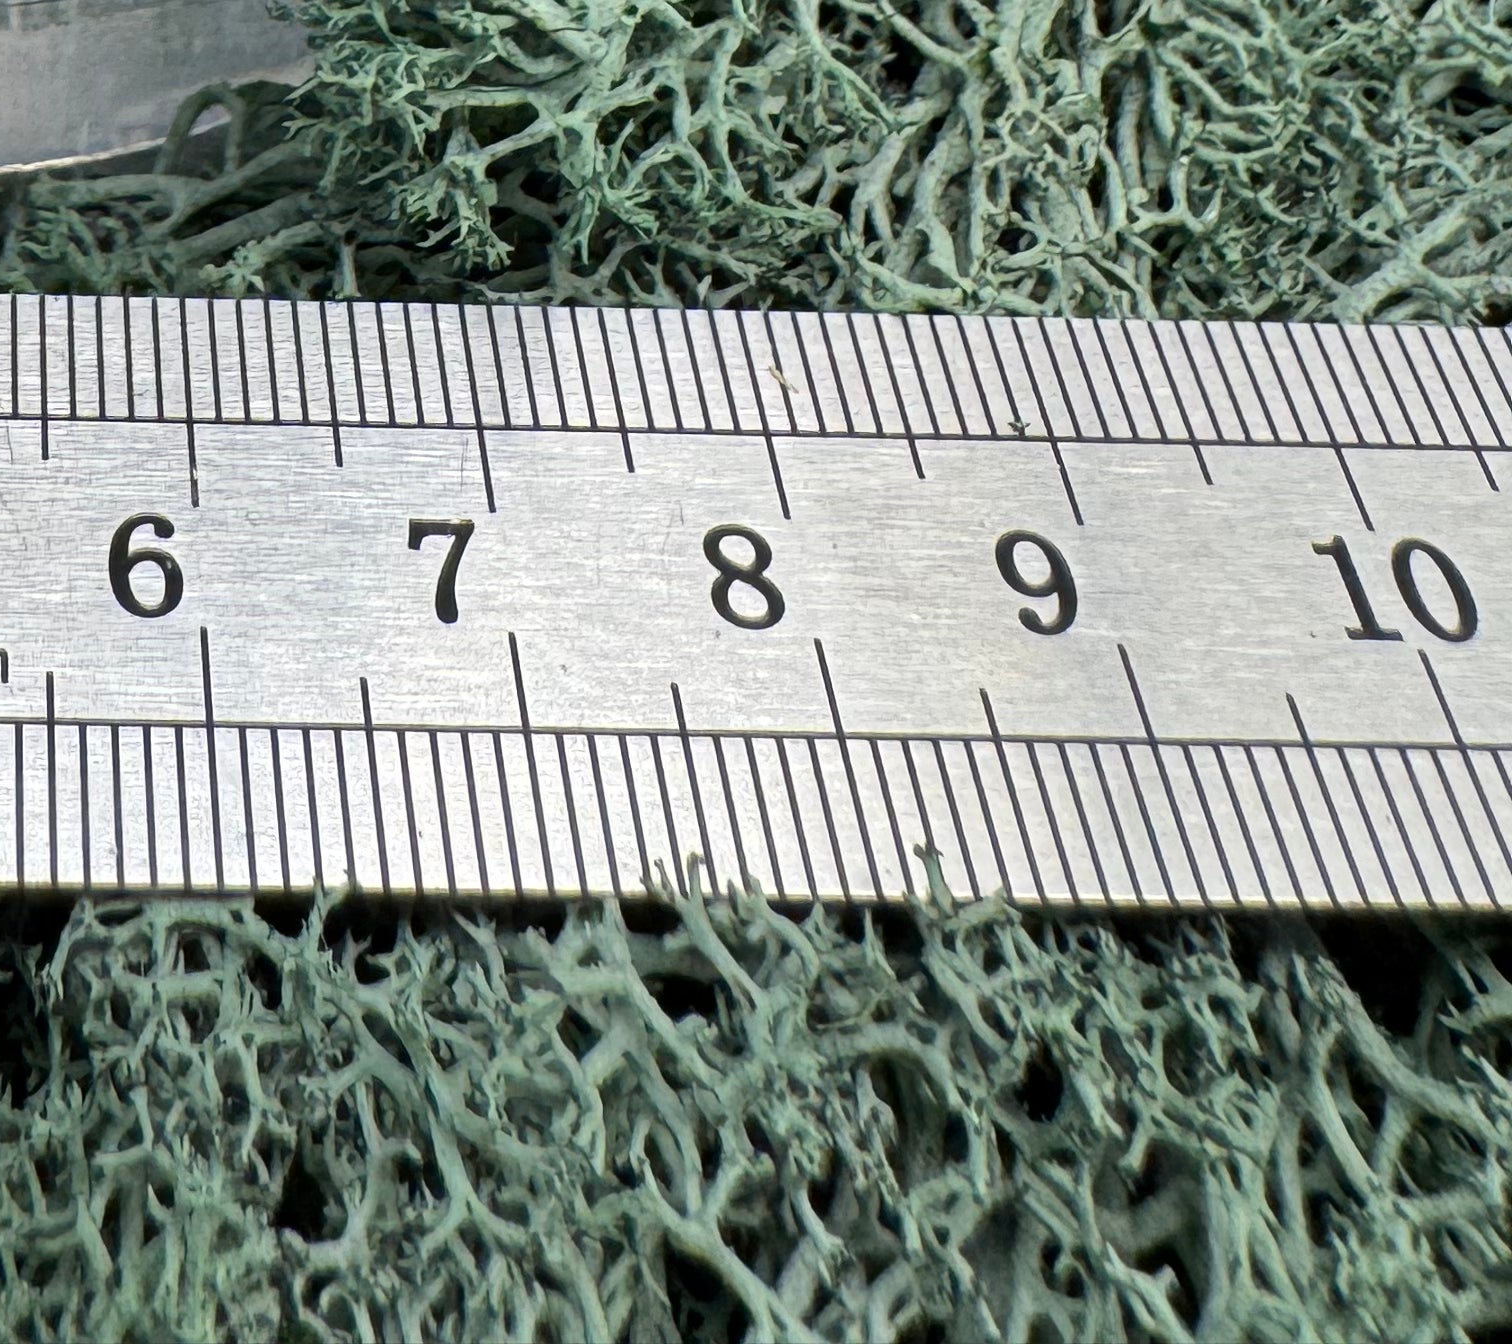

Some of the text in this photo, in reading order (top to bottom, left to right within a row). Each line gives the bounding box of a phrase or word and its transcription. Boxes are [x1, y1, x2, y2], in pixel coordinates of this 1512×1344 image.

[107, 512, 184, 619] 6
[407, 518, 476, 624] 7
[702, 524, 786, 630] 8
[995, 529, 1079, 636] 9
[1311, 535, 1480, 643] 10
